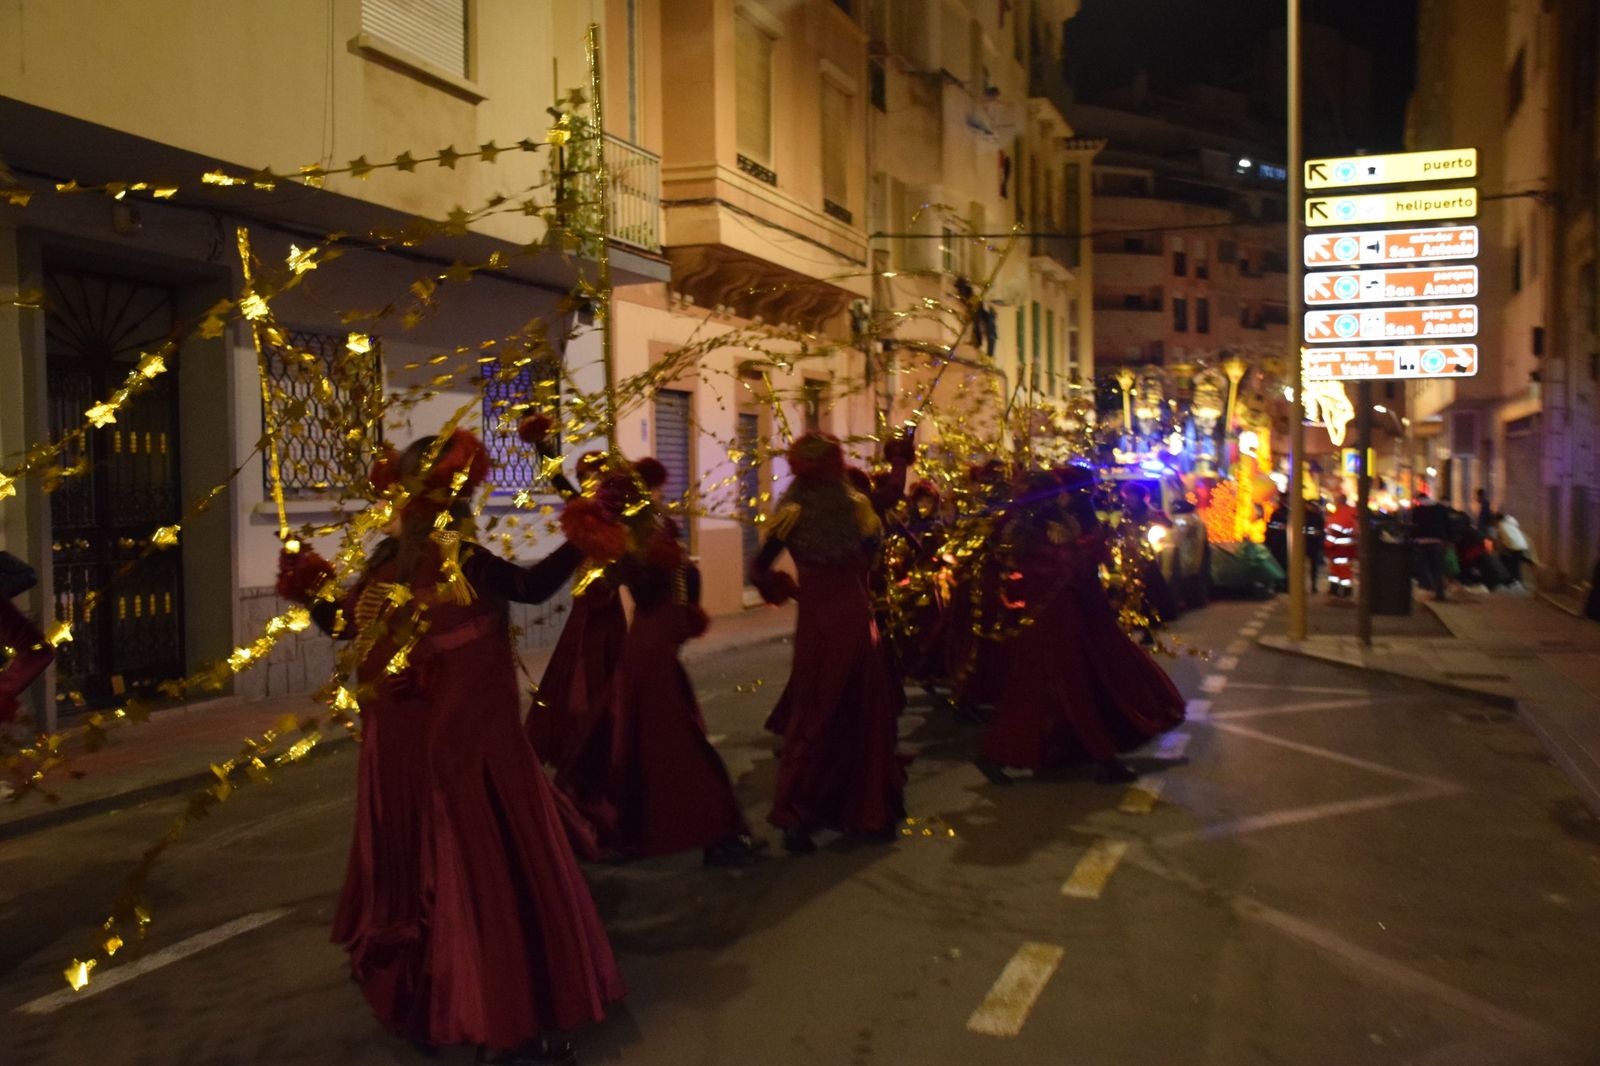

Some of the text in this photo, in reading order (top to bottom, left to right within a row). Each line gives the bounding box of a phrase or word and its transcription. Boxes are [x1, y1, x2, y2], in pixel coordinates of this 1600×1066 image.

[1423, 157, 1473, 171] puerto
[1396, 197, 1473, 211] helipuerto
[1389, 242, 1474, 258] San Antonio
[1385, 282, 1474, 298] San Amaro
[1385, 321, 1474, 336] San Amaro
